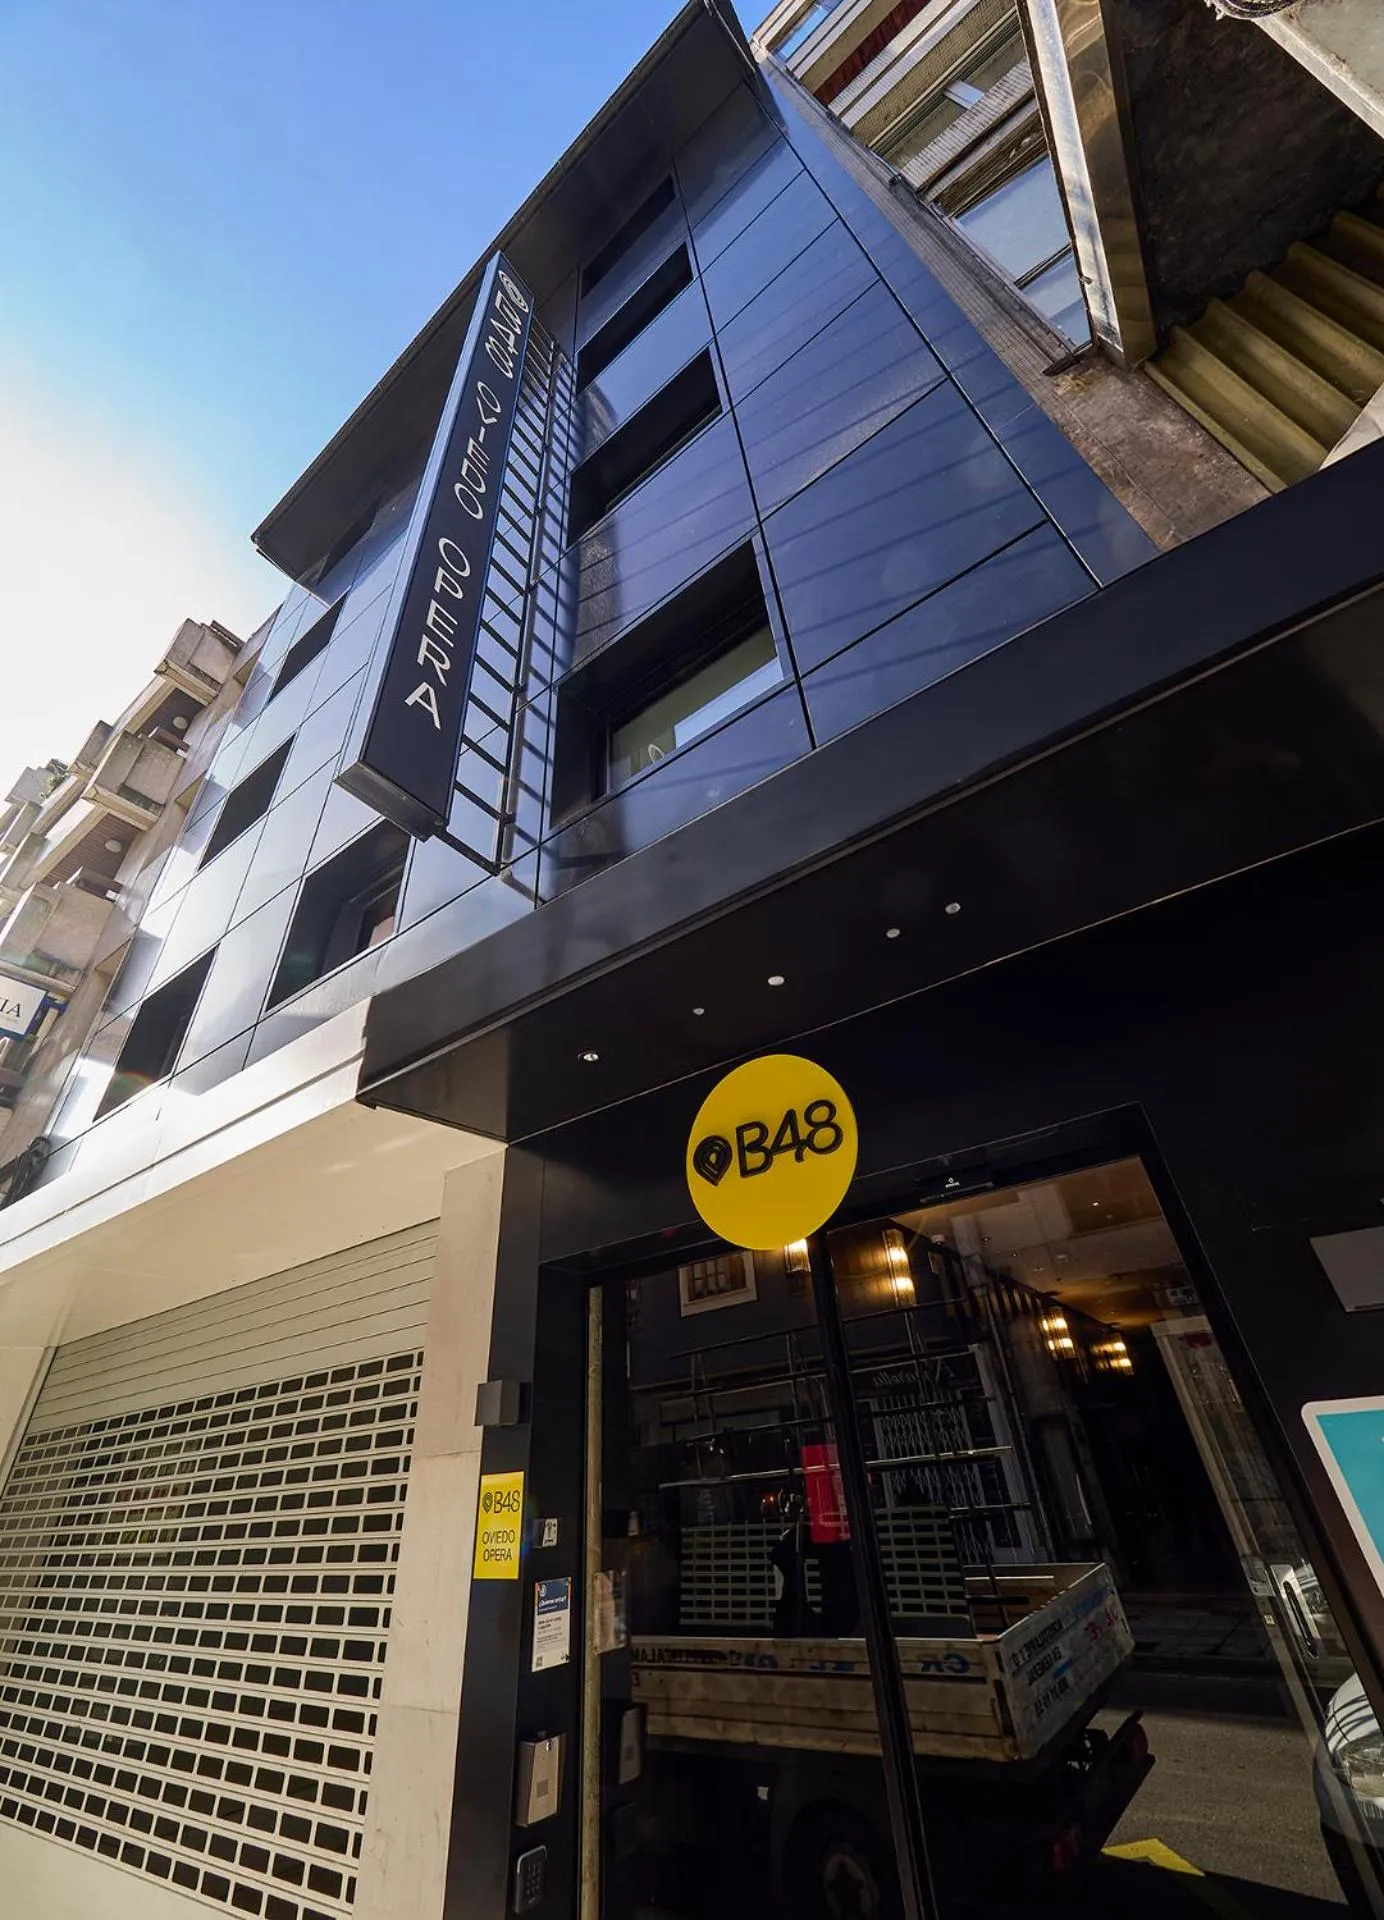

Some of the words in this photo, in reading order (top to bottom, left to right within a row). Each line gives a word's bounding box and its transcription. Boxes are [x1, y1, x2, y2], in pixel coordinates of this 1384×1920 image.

[485, 290, 522, 379] B48
[454, 380, 501, 520] OVIEDO
[405, 537, 471, 731] OPERA
[0, 996, 21, 1018] IA
[735, 1099, 844, 1179] B48
[493, 1490, 521, 1514] B48
[482, 1529, 516, 1545] OVIEDO
[483, 1548, 513, 1562] OPERA
